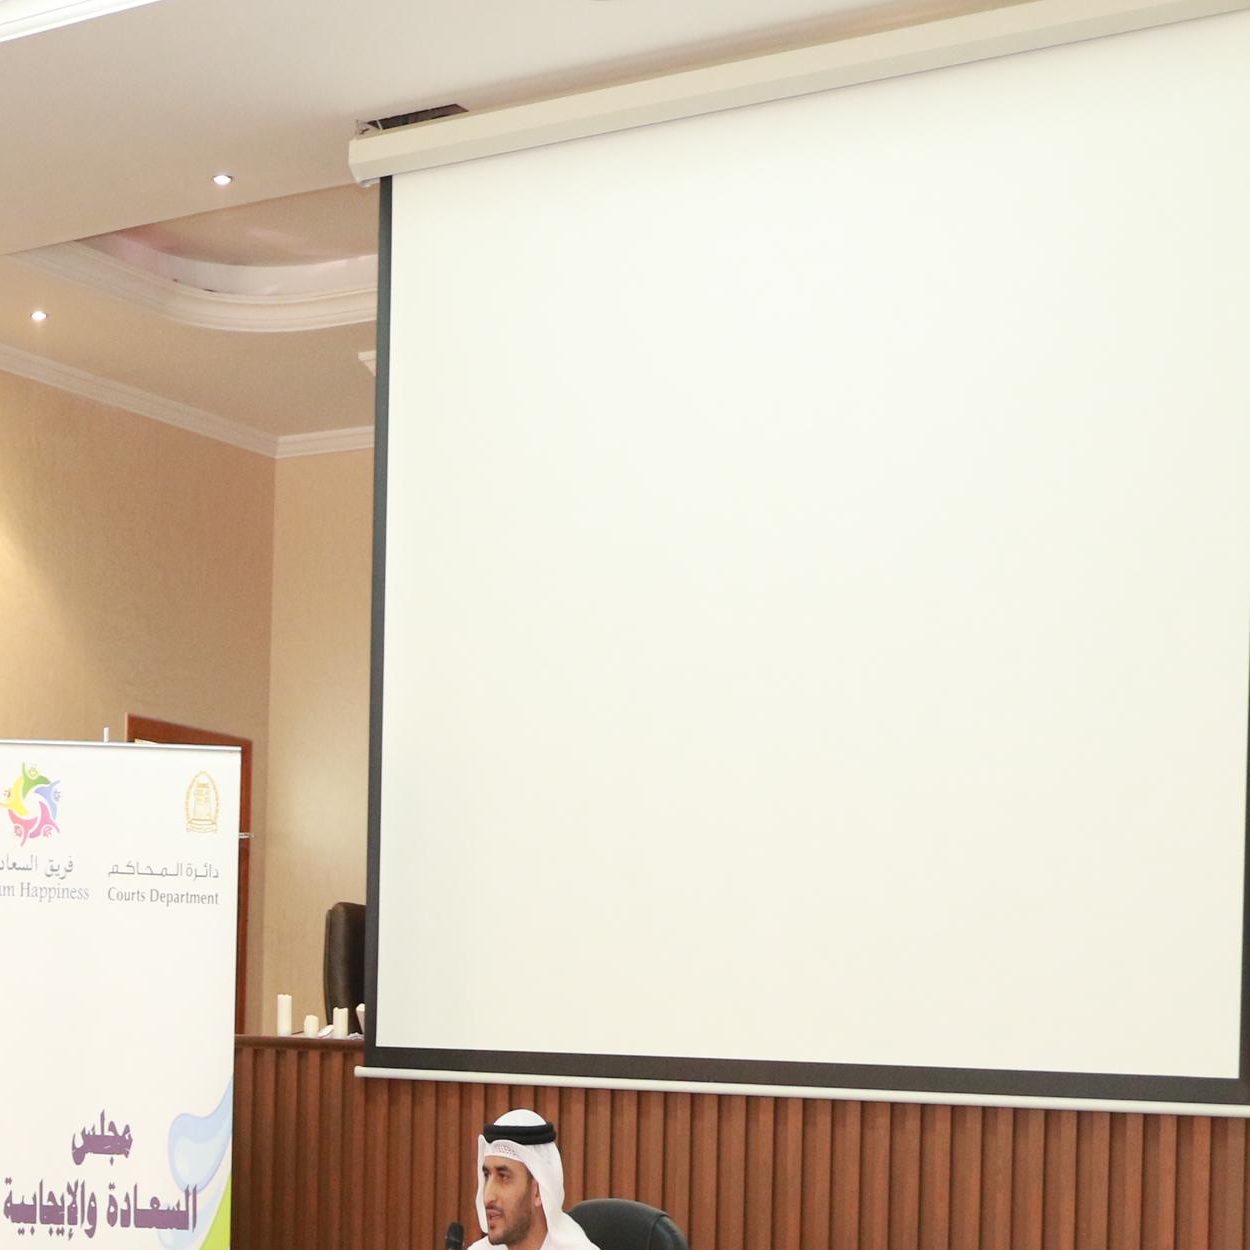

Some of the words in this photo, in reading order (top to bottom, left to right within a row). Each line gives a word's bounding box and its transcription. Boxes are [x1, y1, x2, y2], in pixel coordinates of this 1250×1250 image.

[45, 855, 74, 880] فريق
[108, 860, 183, 877] المحاكم
[185, 862, 219, 881] دائرة
[20, 881, 90, 903] Happiness
[107, 886, 146, 902] Courts
[150, 888, 220, 908] Department
[71, 1109, 133, 1166] مجلس
[3, 1177, 98, 1240] والإيجابية
[106, 1182, 198, 1233] السعادة
